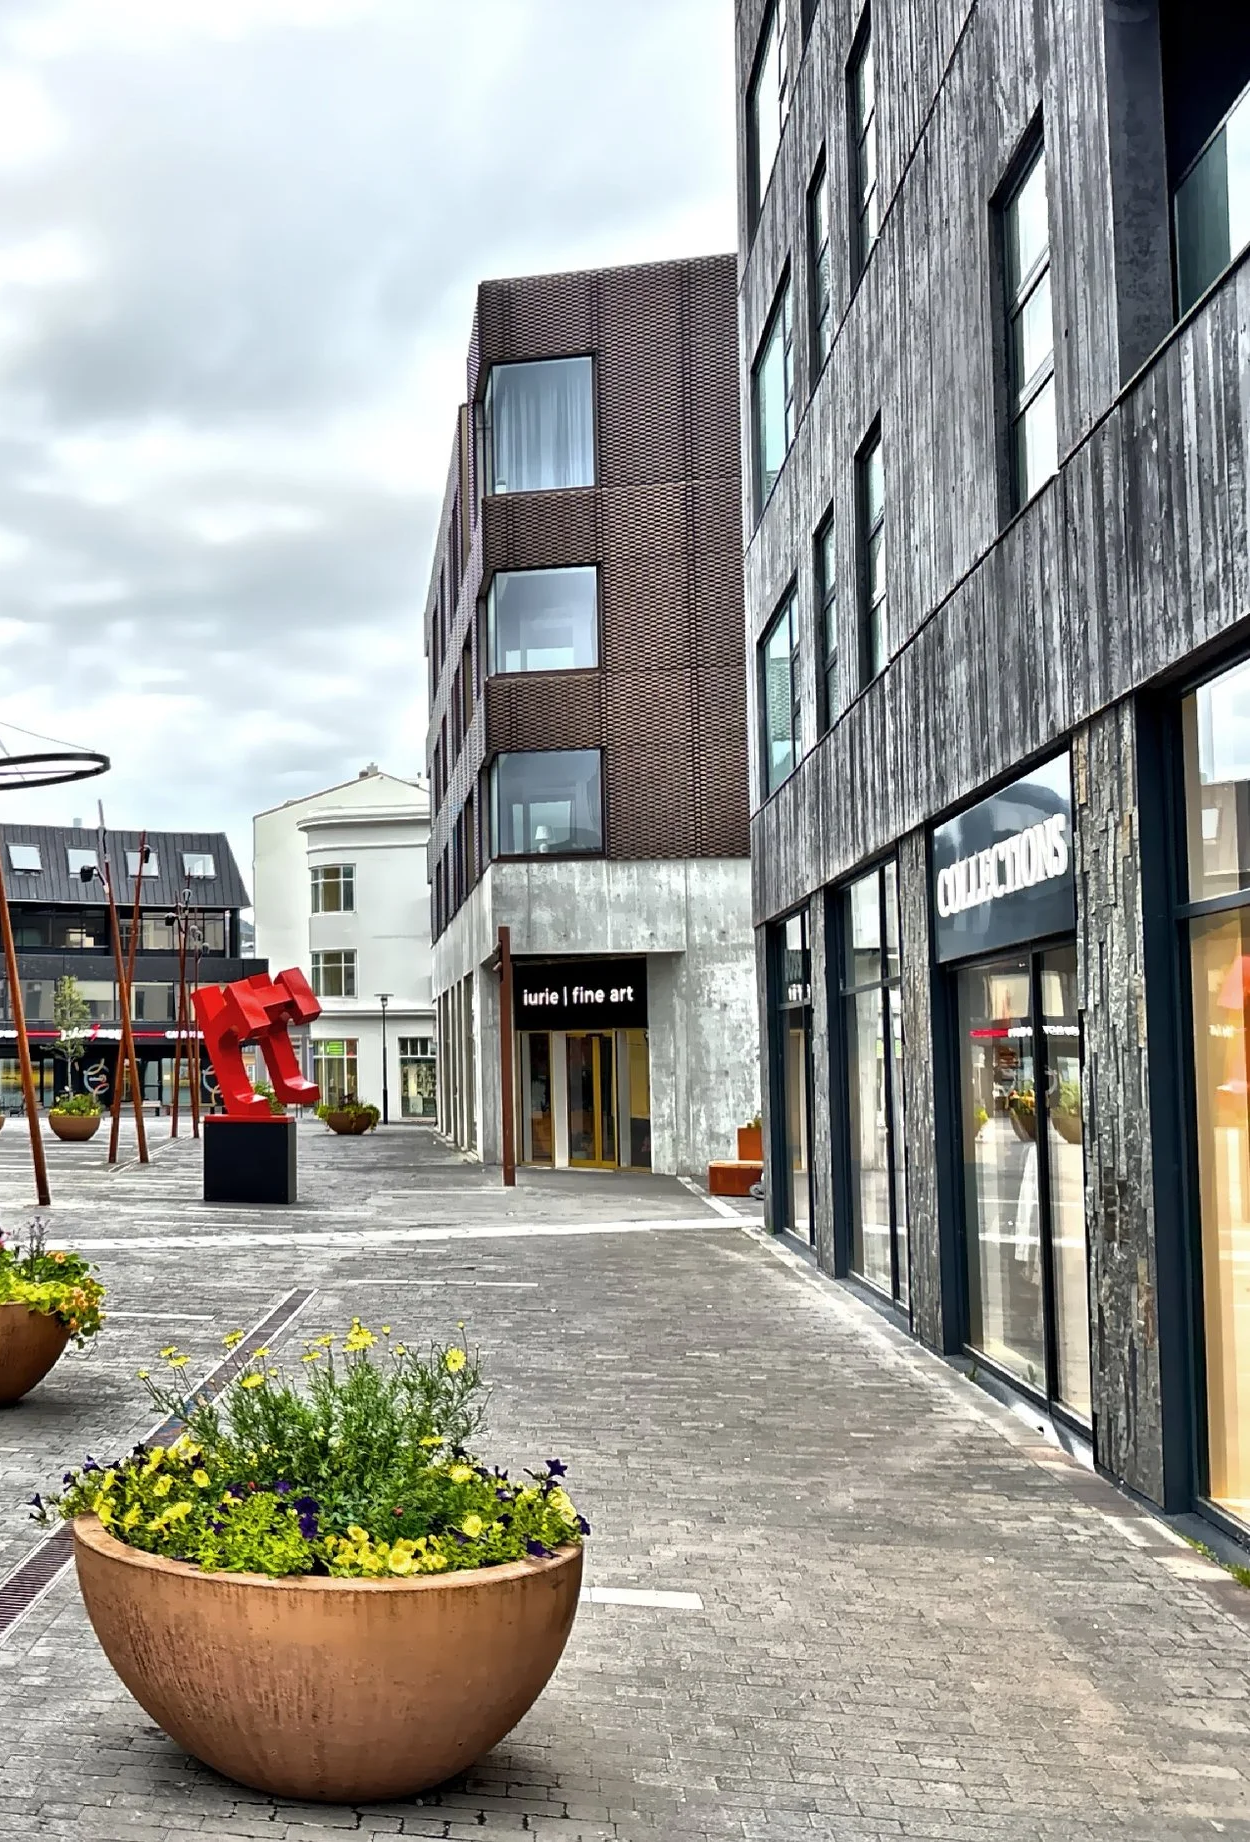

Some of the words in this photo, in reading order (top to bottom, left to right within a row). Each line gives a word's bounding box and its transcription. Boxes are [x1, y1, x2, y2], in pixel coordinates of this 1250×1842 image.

[937, 813, 1068, 918] COLLECTIONS
[523, 988, 559, 1006] iurie
[572, 986, 605, 1004] fine
[609, 986, 634, 1002] art
